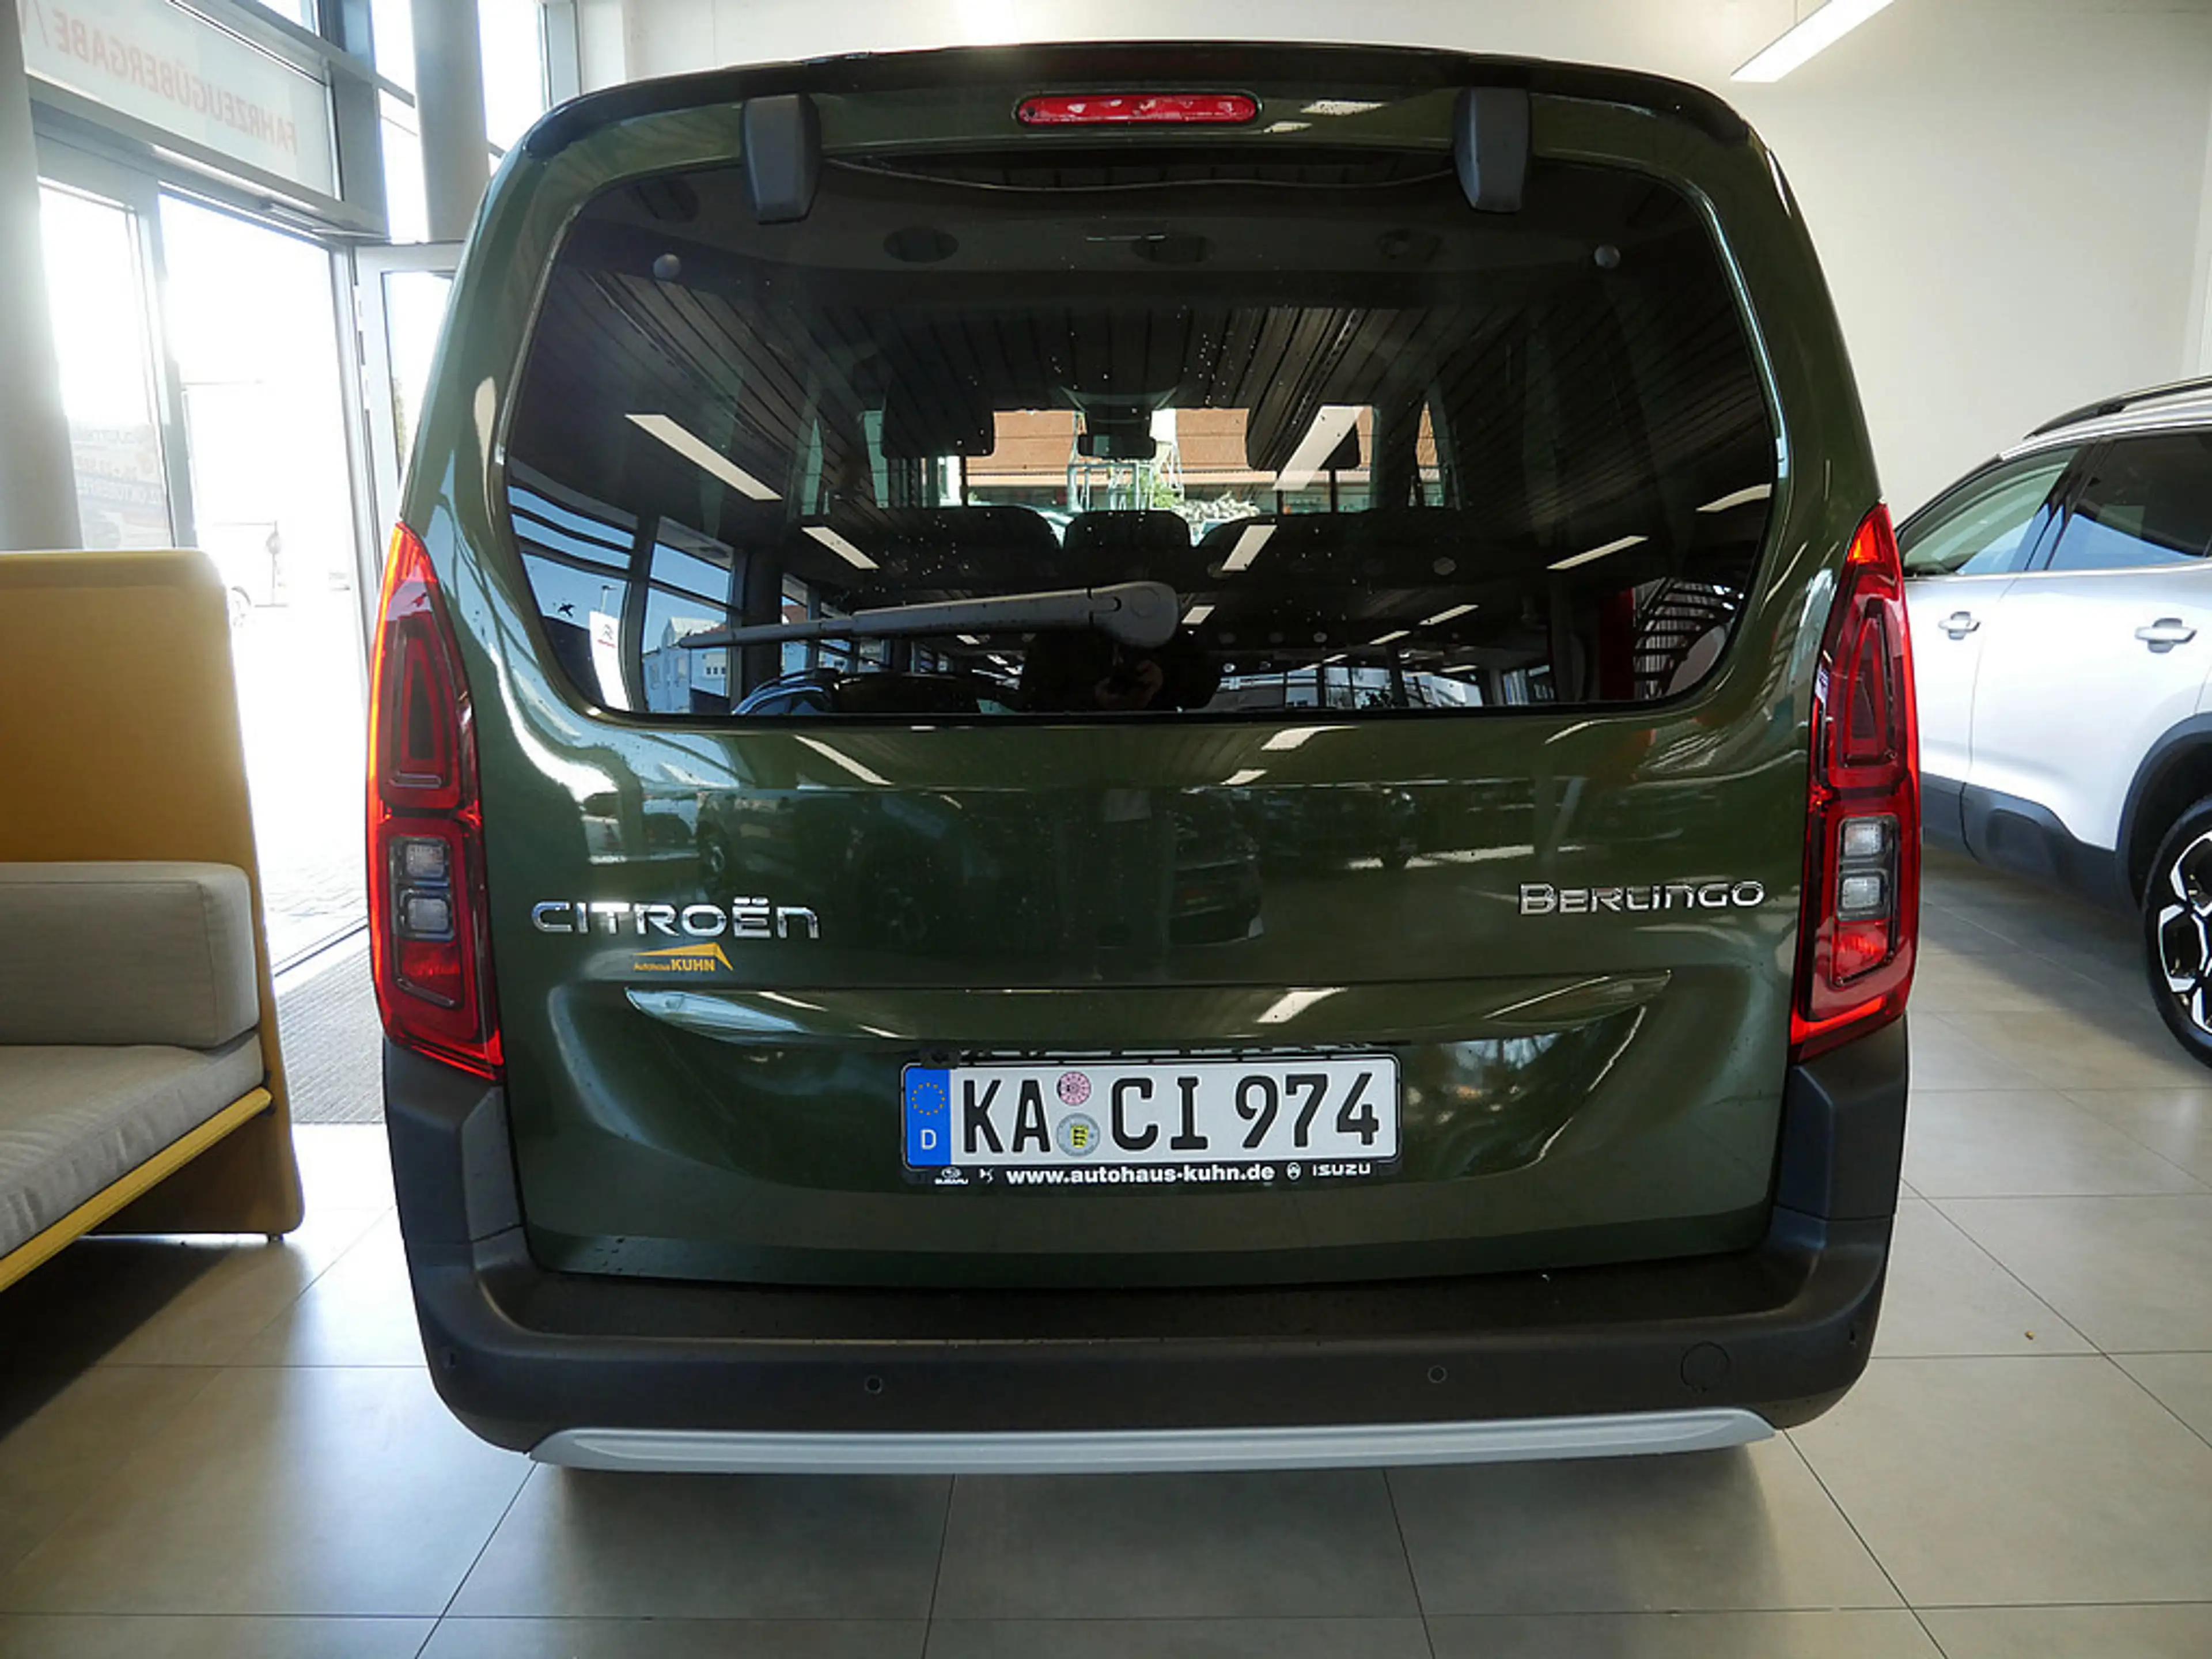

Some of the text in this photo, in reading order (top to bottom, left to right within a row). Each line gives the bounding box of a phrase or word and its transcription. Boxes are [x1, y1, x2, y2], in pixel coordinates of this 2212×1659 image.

[531, 897, 820, 939] CITROËN
[964, 1079, 1051, 1153] KA
[1111, 1076, 1209, 1150] CI
[1235, 1072, 1379, 1148] 974
[921, 1129, 937, 1149] D
[1006, 1164, 1275, 1184] www.autohaus-kuhn.de
